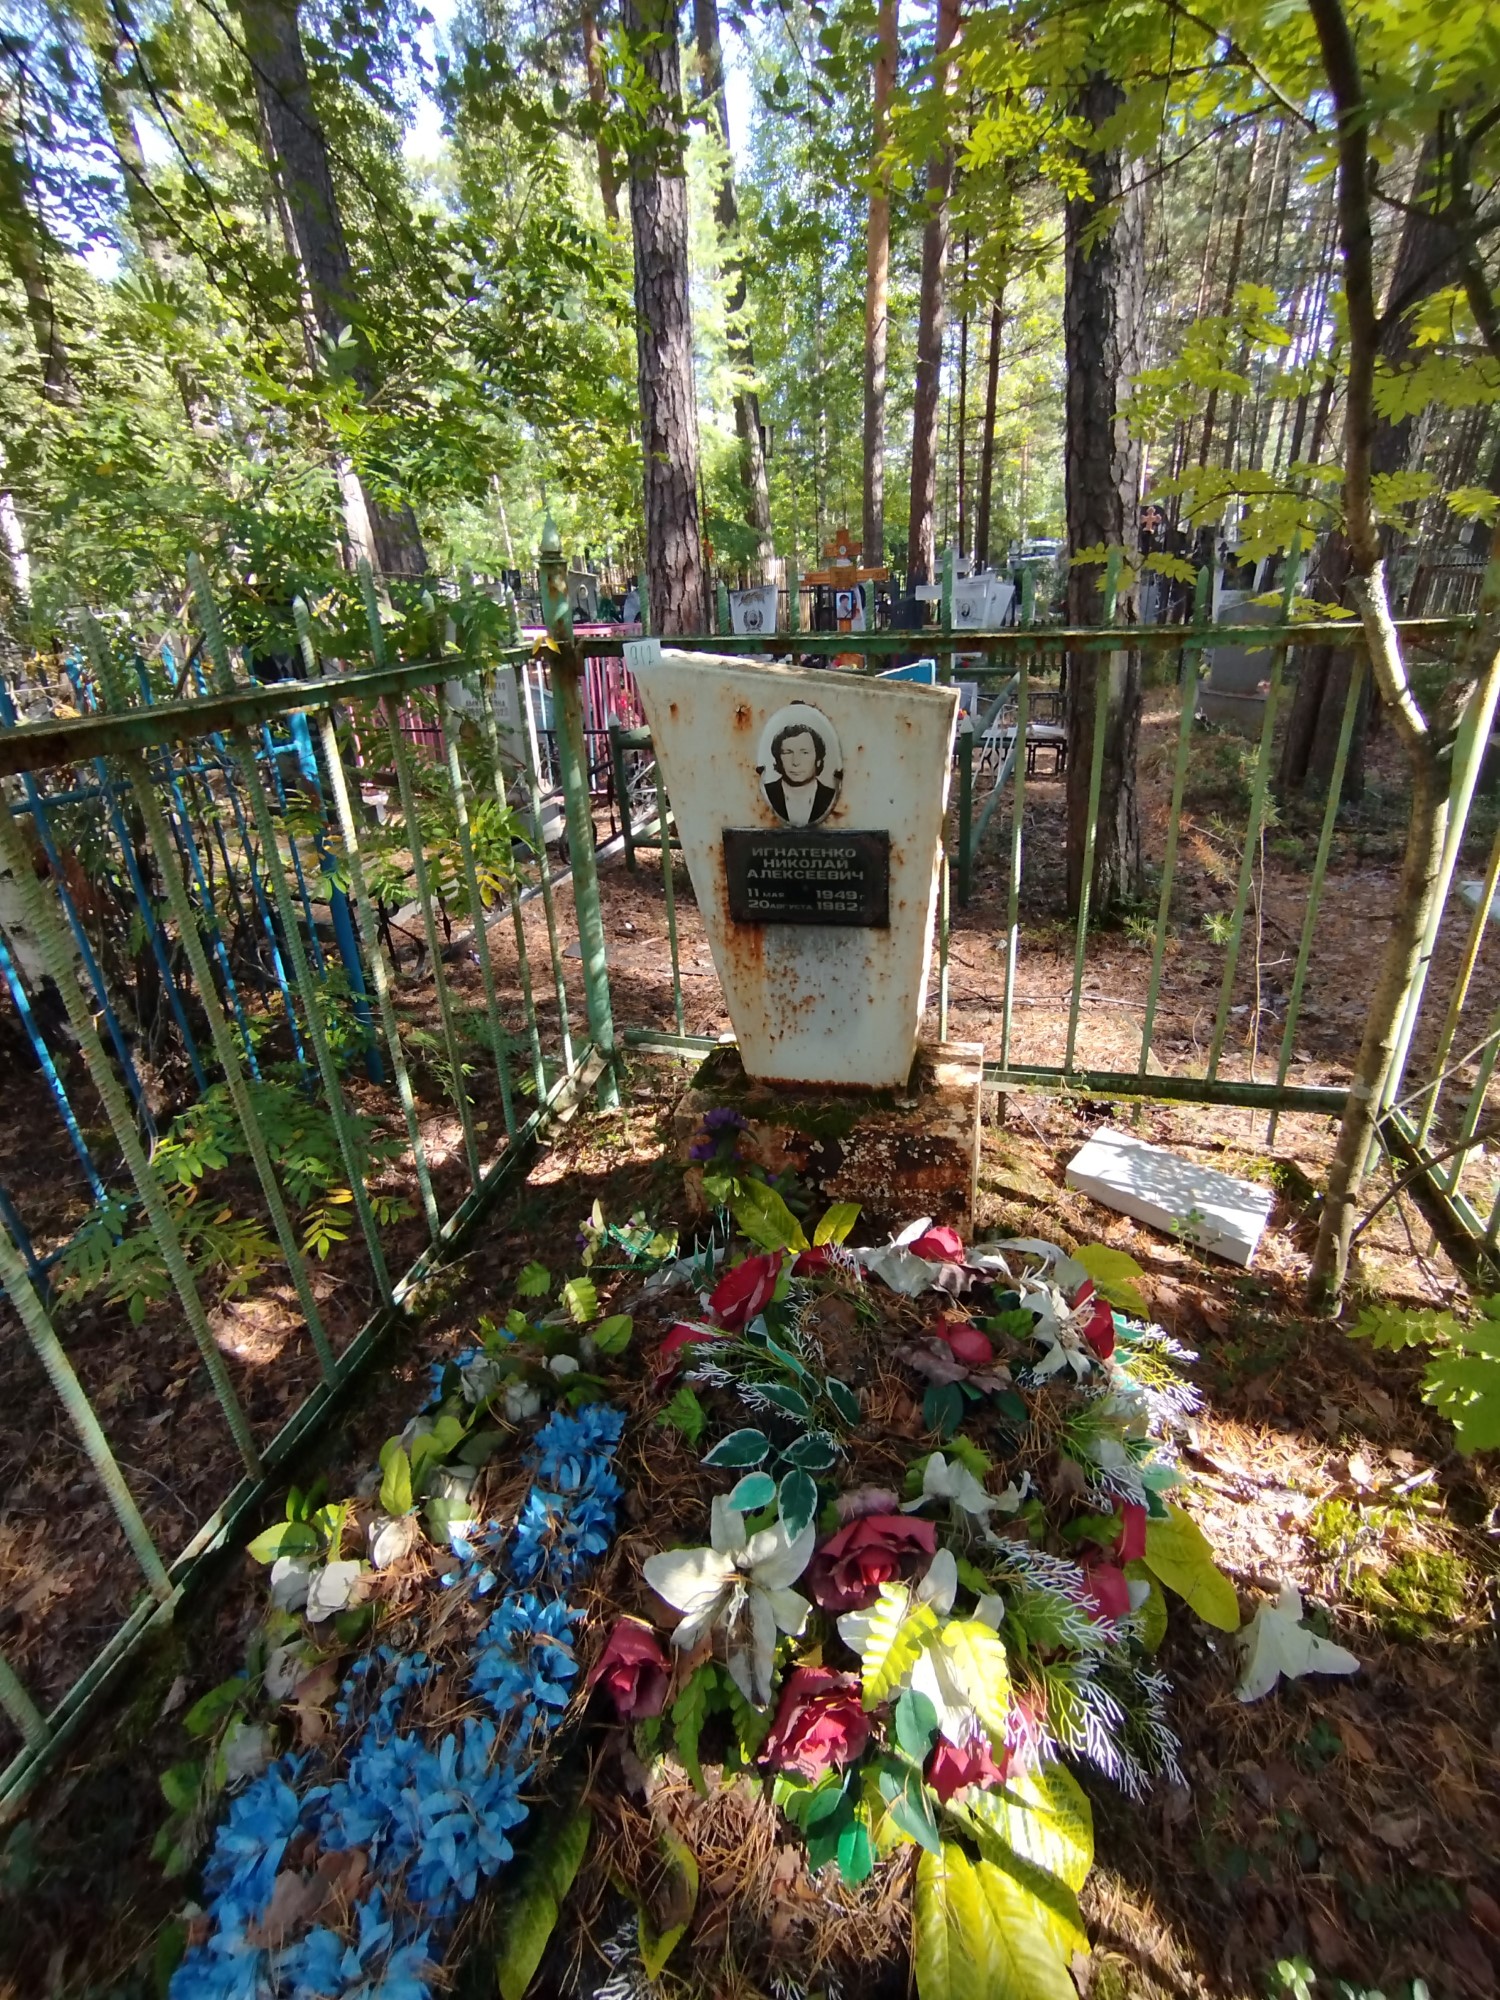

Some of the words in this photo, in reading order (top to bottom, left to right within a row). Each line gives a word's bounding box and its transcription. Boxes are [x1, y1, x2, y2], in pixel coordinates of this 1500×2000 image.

[752, 848, 856, 858] ИГНАТЕНКО
[763, 857, 849, 869] НИКОЛАЙ
[747, 869, 864, 880] АЛЕКСЕЕВИЧ
[747, 888, 759, 897] 11
[816, 890, 858, 900] 1949
[748, 899, 770, 909] 20
[816, 902, 858, 912] 1982
